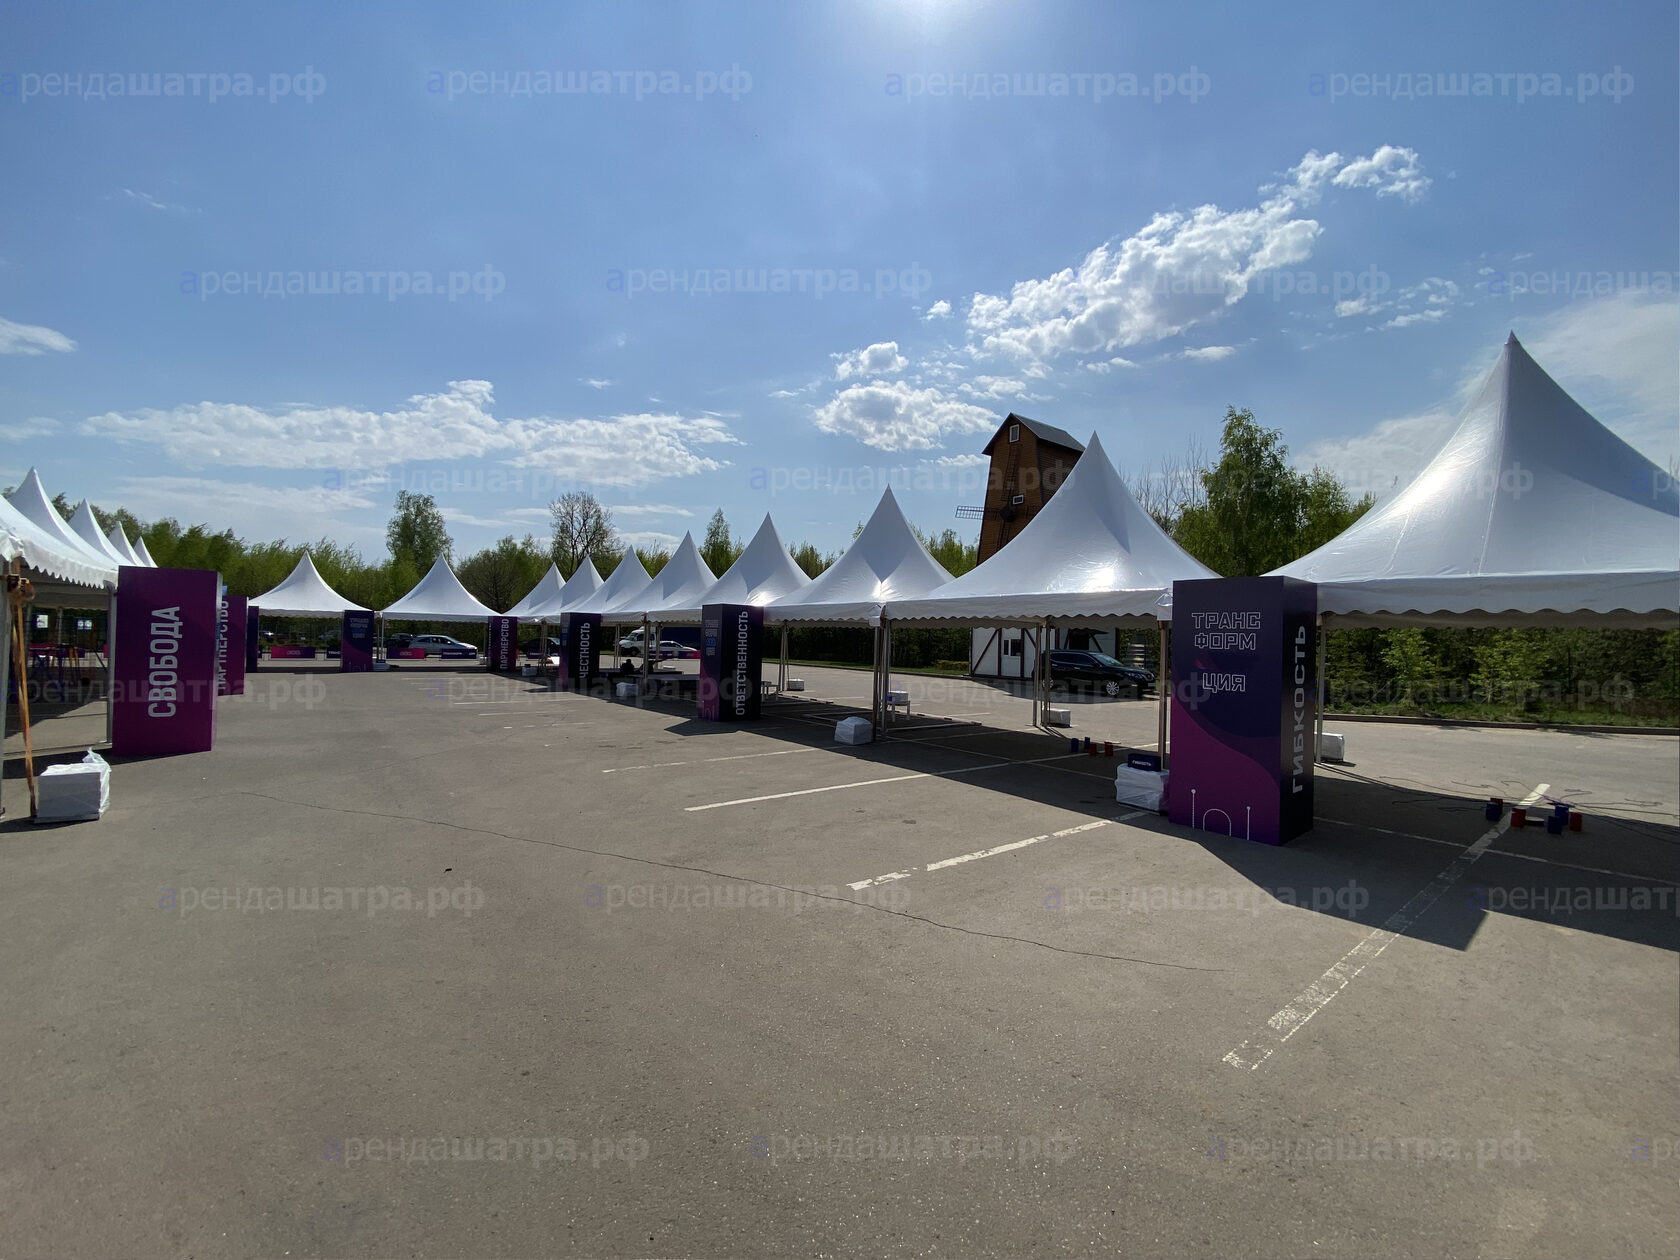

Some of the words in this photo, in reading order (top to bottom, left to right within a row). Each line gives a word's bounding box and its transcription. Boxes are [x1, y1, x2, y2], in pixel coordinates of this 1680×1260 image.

[500, 618, 510, 669] ПАРТНЕРСТВО
[1191, 611, 1261, 630] ТРАНС
[1194, 632, 1256, 651] ФОРМ
[148, 606, 183, 718] СВОБОДА
[579, 622, 591, 679] ЧЕСТНОСТЬ
[736, 611, 749, 715] ОТВЕТСТВЕННОСТЬ
[1202, 672, 1246, 694] ЦИЯ
[1292, 625, 1306, 794] ГИБКОСТЬ
